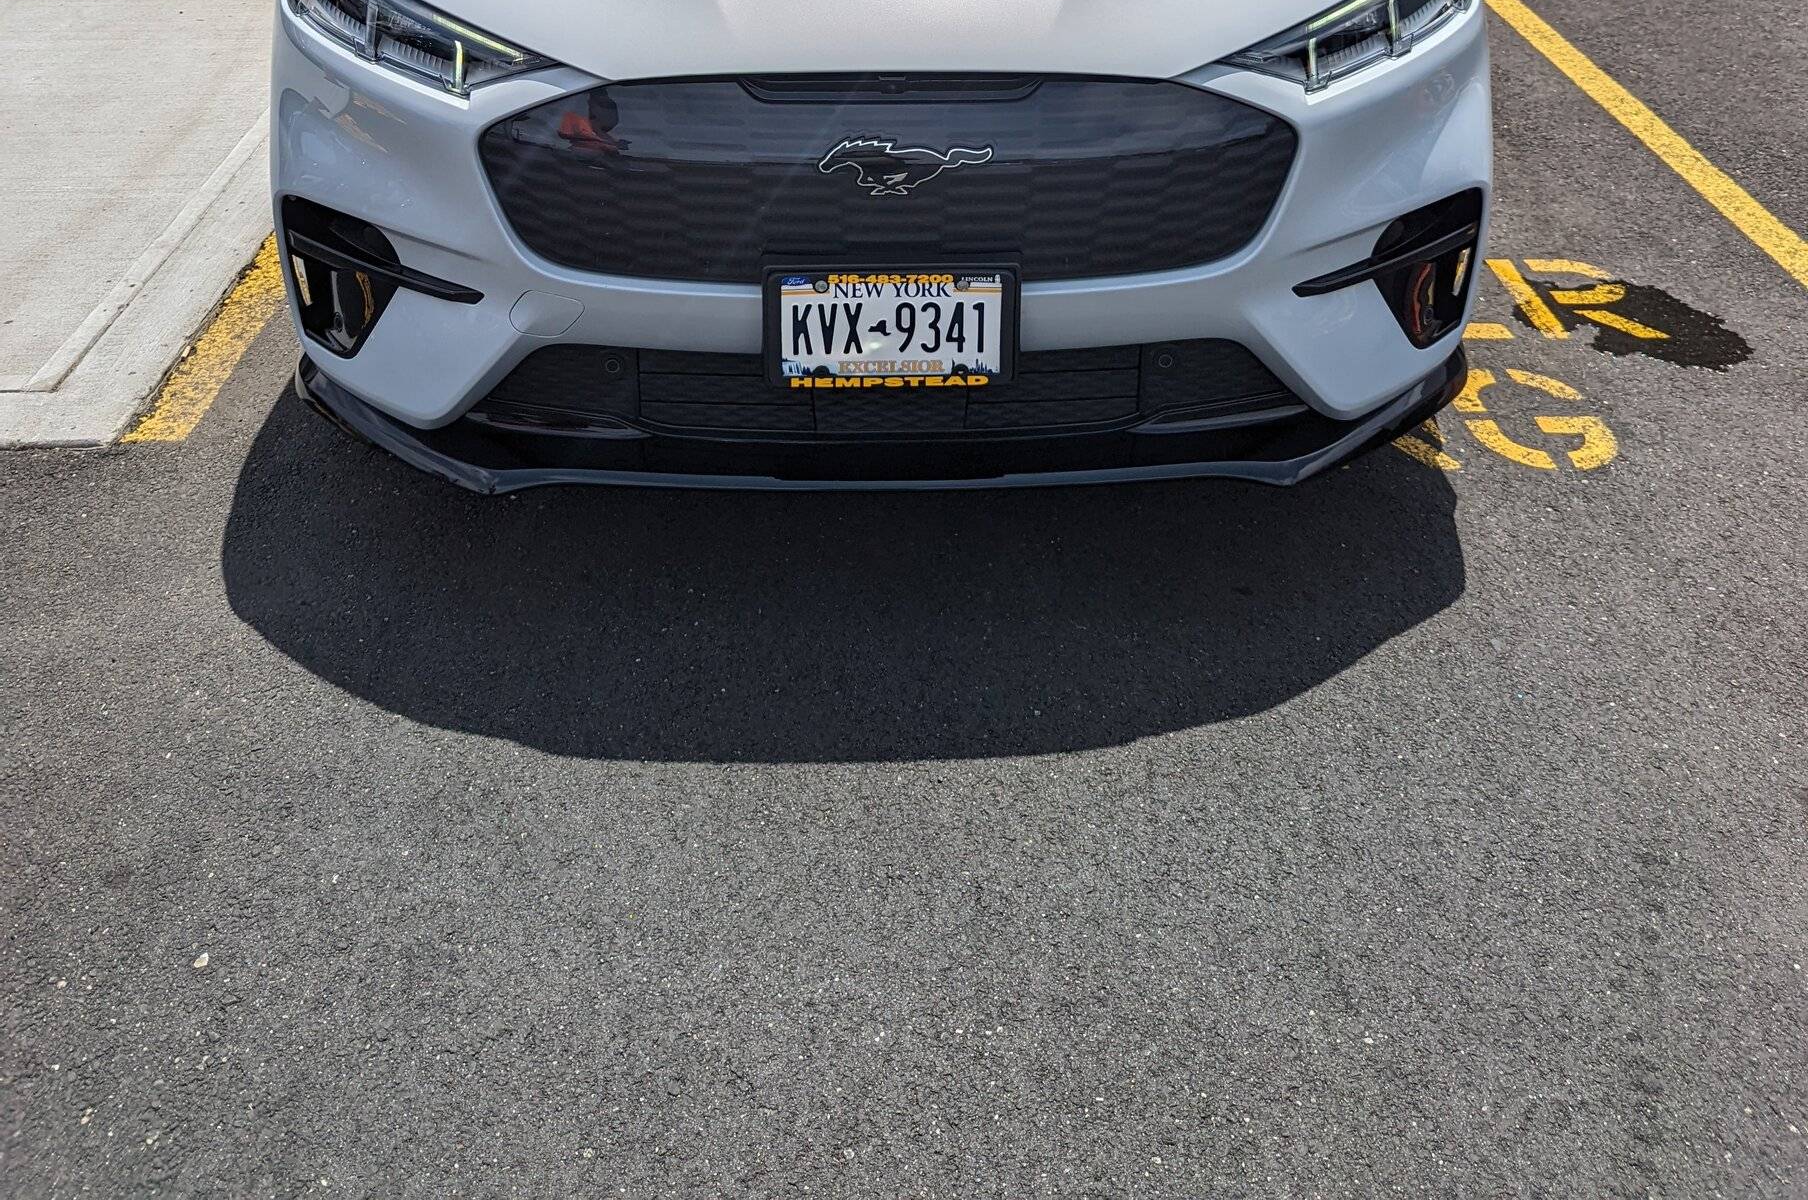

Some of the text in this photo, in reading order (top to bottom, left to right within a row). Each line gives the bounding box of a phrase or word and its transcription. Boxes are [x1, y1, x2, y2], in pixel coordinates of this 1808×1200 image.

[787, 277, 805, 285] Ford
[827, 275, 953, 284] 516-483-7200
[833, 283, 952, 299] NEW YORK
[792, 302, 985, 355] KVX 9341
[838, 360, 945, 374] EXCELSIOR
[790, 375, 989, 388] HEMPSTEAD
